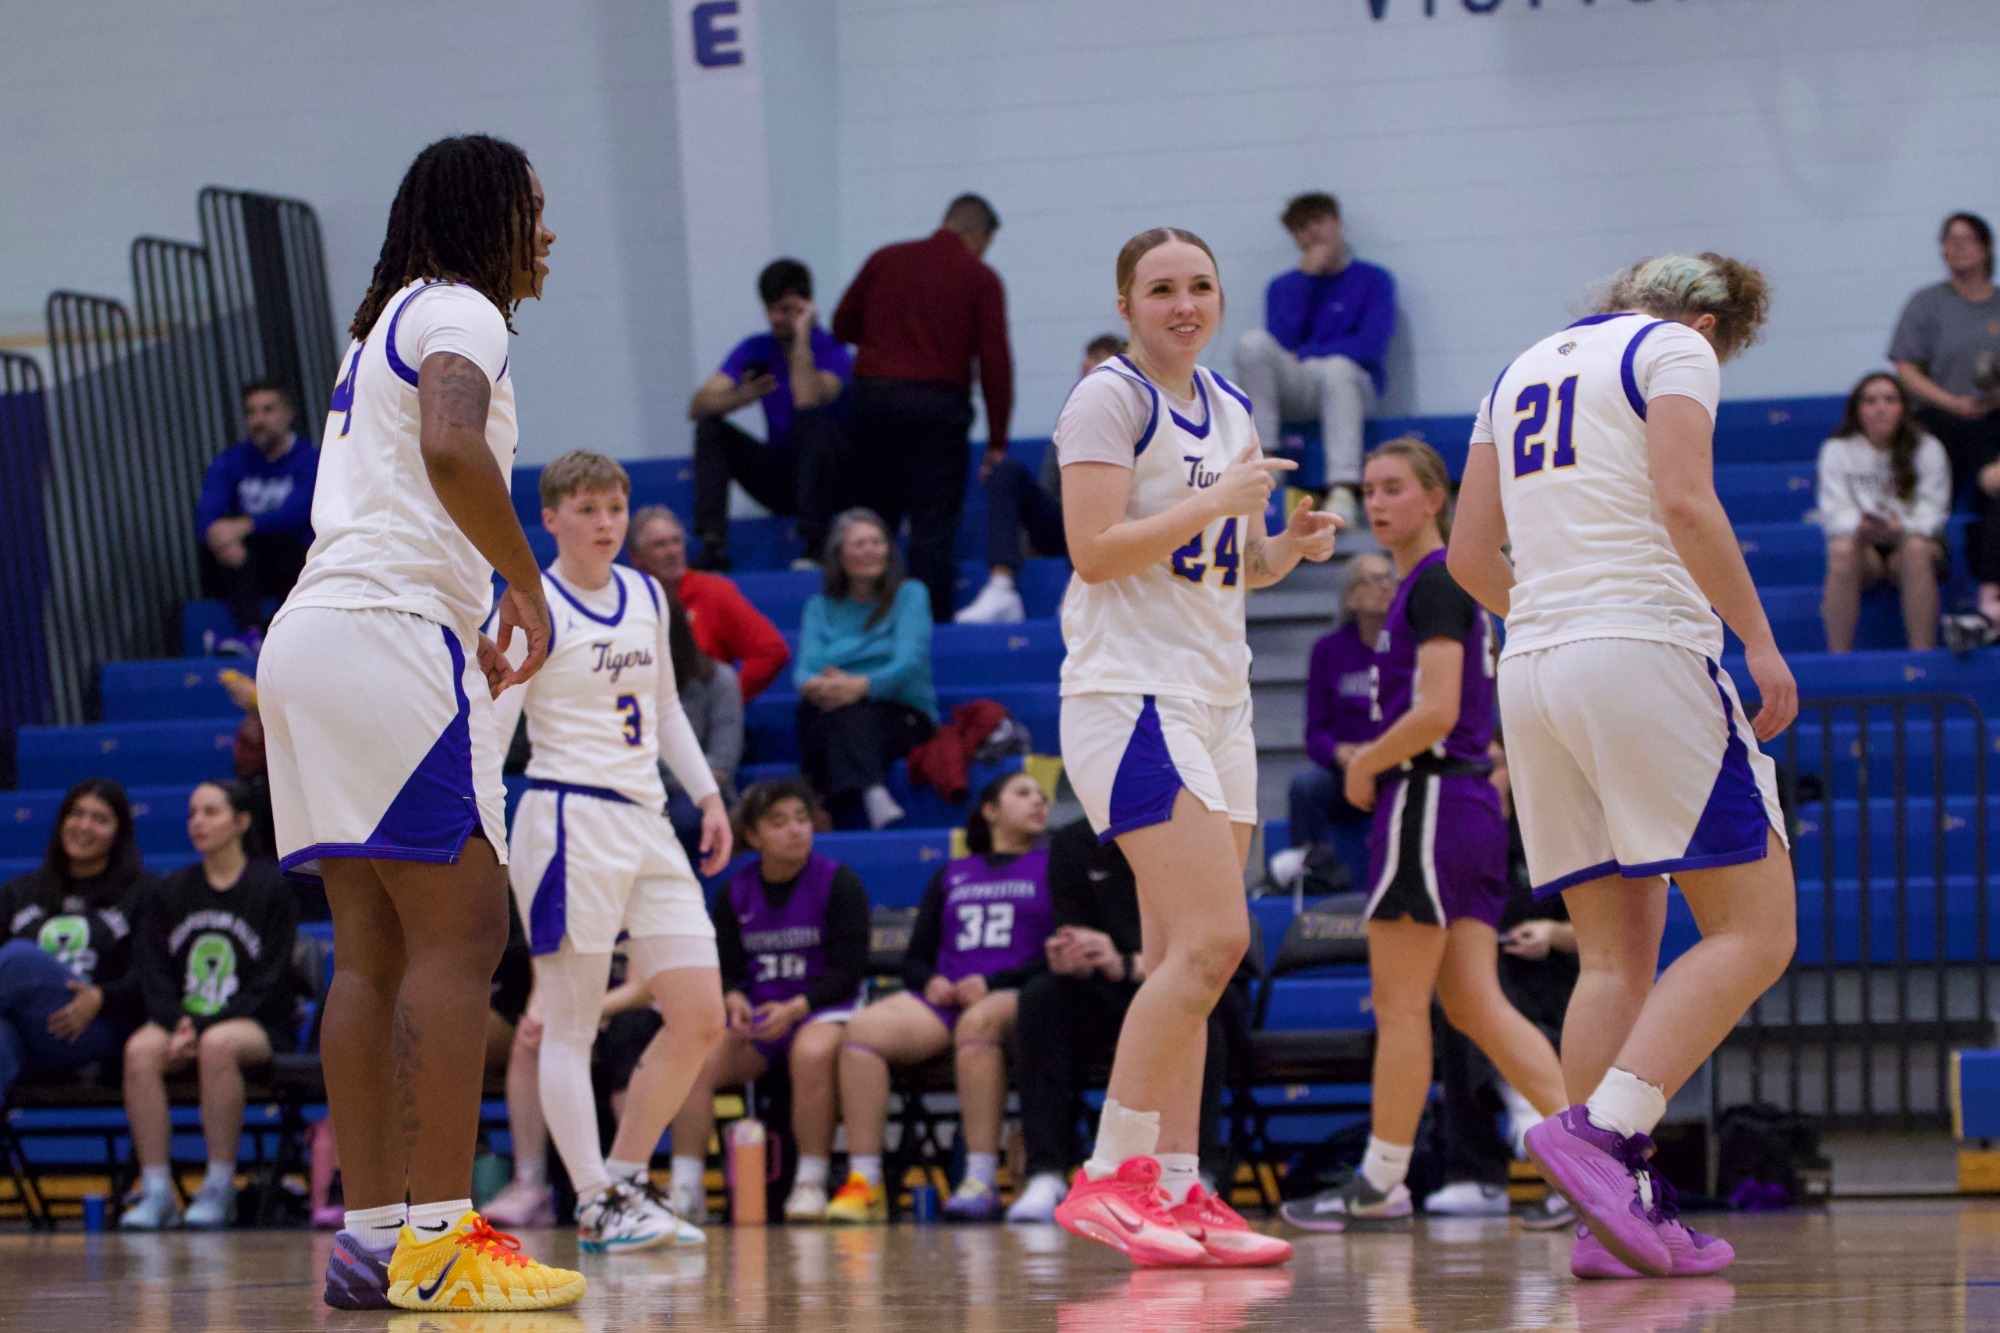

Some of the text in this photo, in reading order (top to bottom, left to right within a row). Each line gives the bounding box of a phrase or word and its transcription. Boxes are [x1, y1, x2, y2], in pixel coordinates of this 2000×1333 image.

[692, 1, 743, 68] E
[1513, 373, 1580, 480] 21
[1183, 455, 1221, 489] Tig
[1170, 515, 1240, 588] 24
[592, 641, 653, 683] Tigers
[615, 692, 644, 747] 3
[956, 902, 1015, 951] 32
